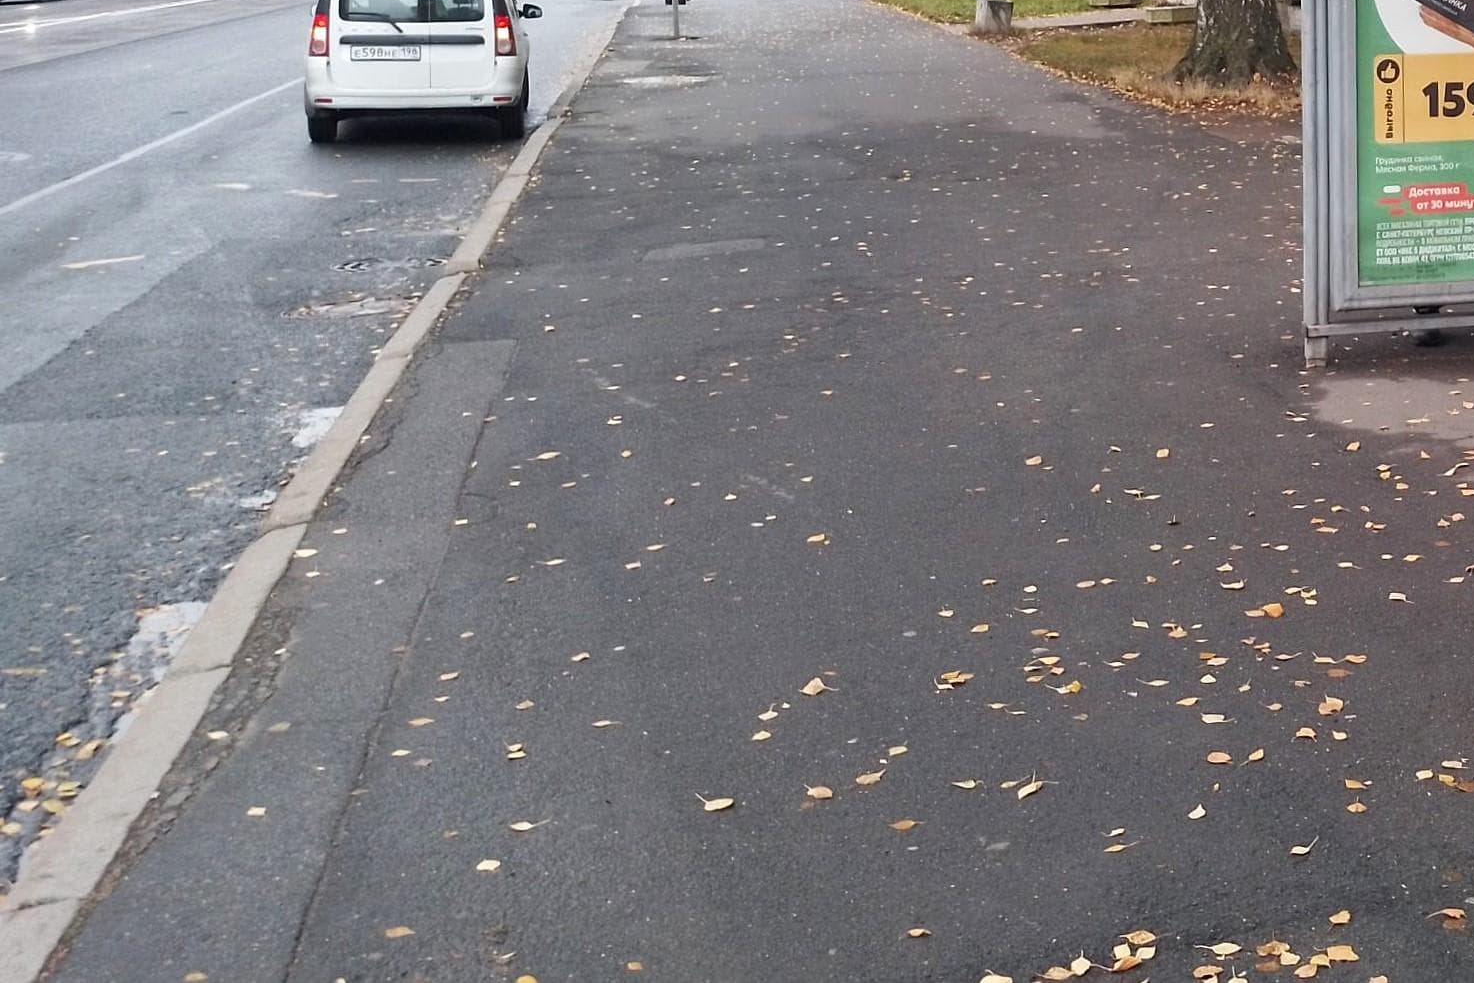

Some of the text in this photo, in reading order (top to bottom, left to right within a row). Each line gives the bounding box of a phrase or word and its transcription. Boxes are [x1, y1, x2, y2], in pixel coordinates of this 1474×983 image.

[1384, 88, 1393, 139] Выгодно
[1408, 186, 1460, 199] Доставка
[1416, 201, 1428, 210] от
[1430, 200, 1443, 209] 30
